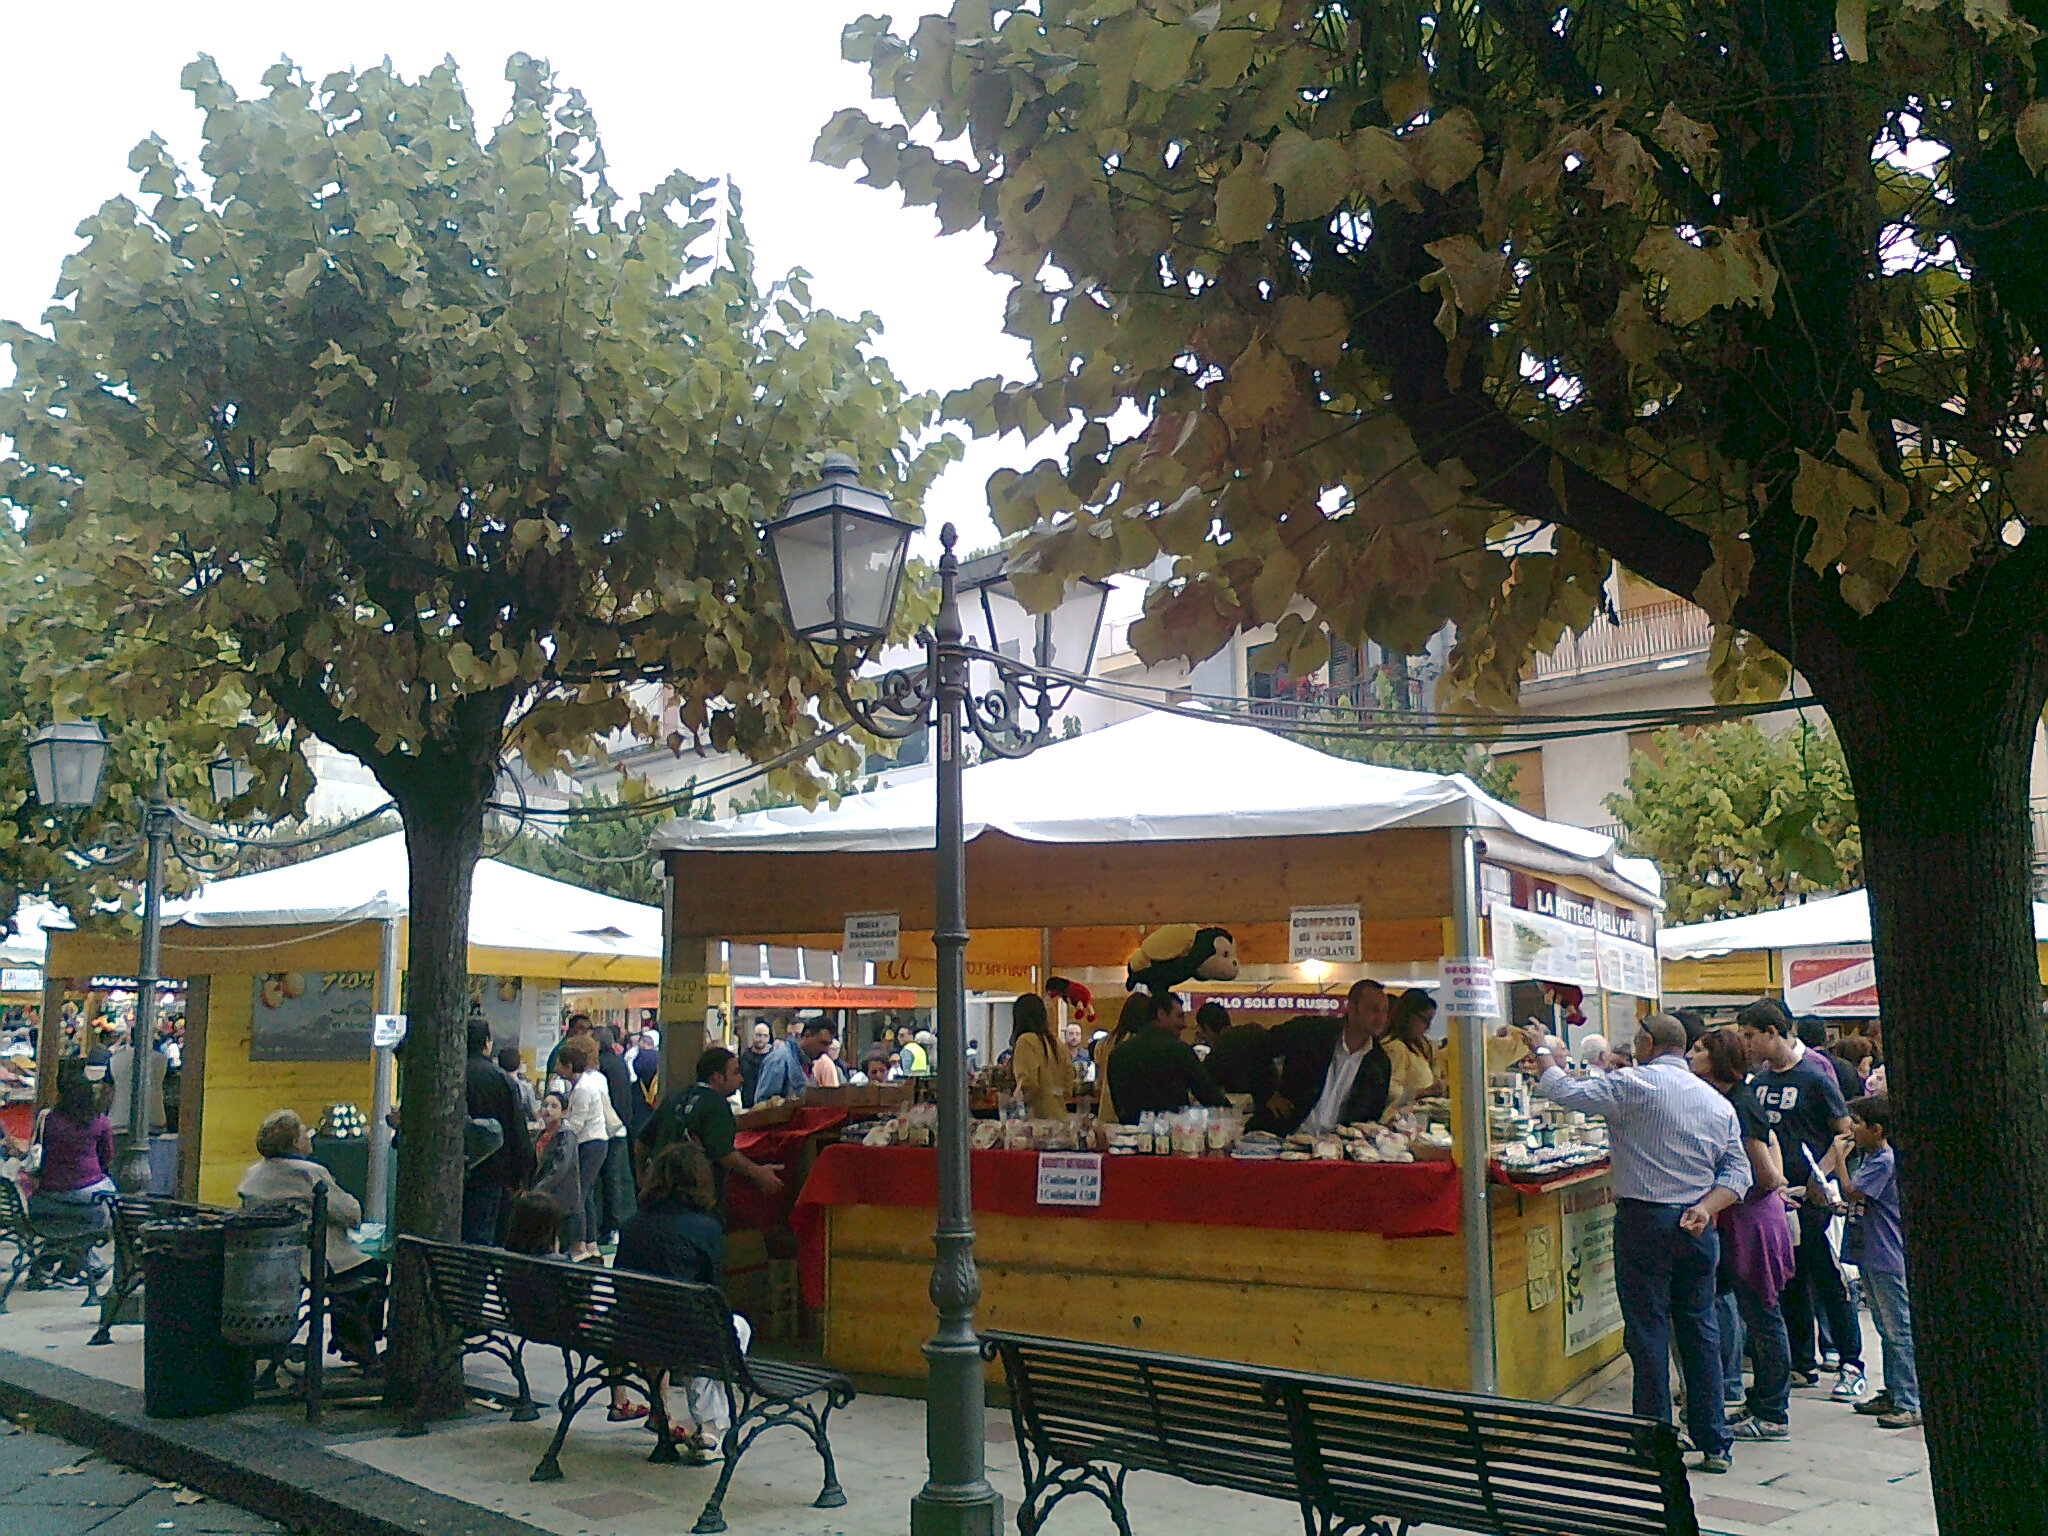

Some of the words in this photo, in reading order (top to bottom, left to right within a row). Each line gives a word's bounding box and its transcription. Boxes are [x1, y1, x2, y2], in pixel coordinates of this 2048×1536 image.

[1536, 889, 1554, 914] LA
[1555, 896, 1597, 928] BOTTEGA
[1597, 911, 1637, 939] DELL'APE
[1293, 917, 1356, 928] COMPOSTO
[1244, 998, 1276, 1009] SOLE
[1277, 998, 1294, 1008] DI
[1296, 998, 1340, 1010] RUSSO
